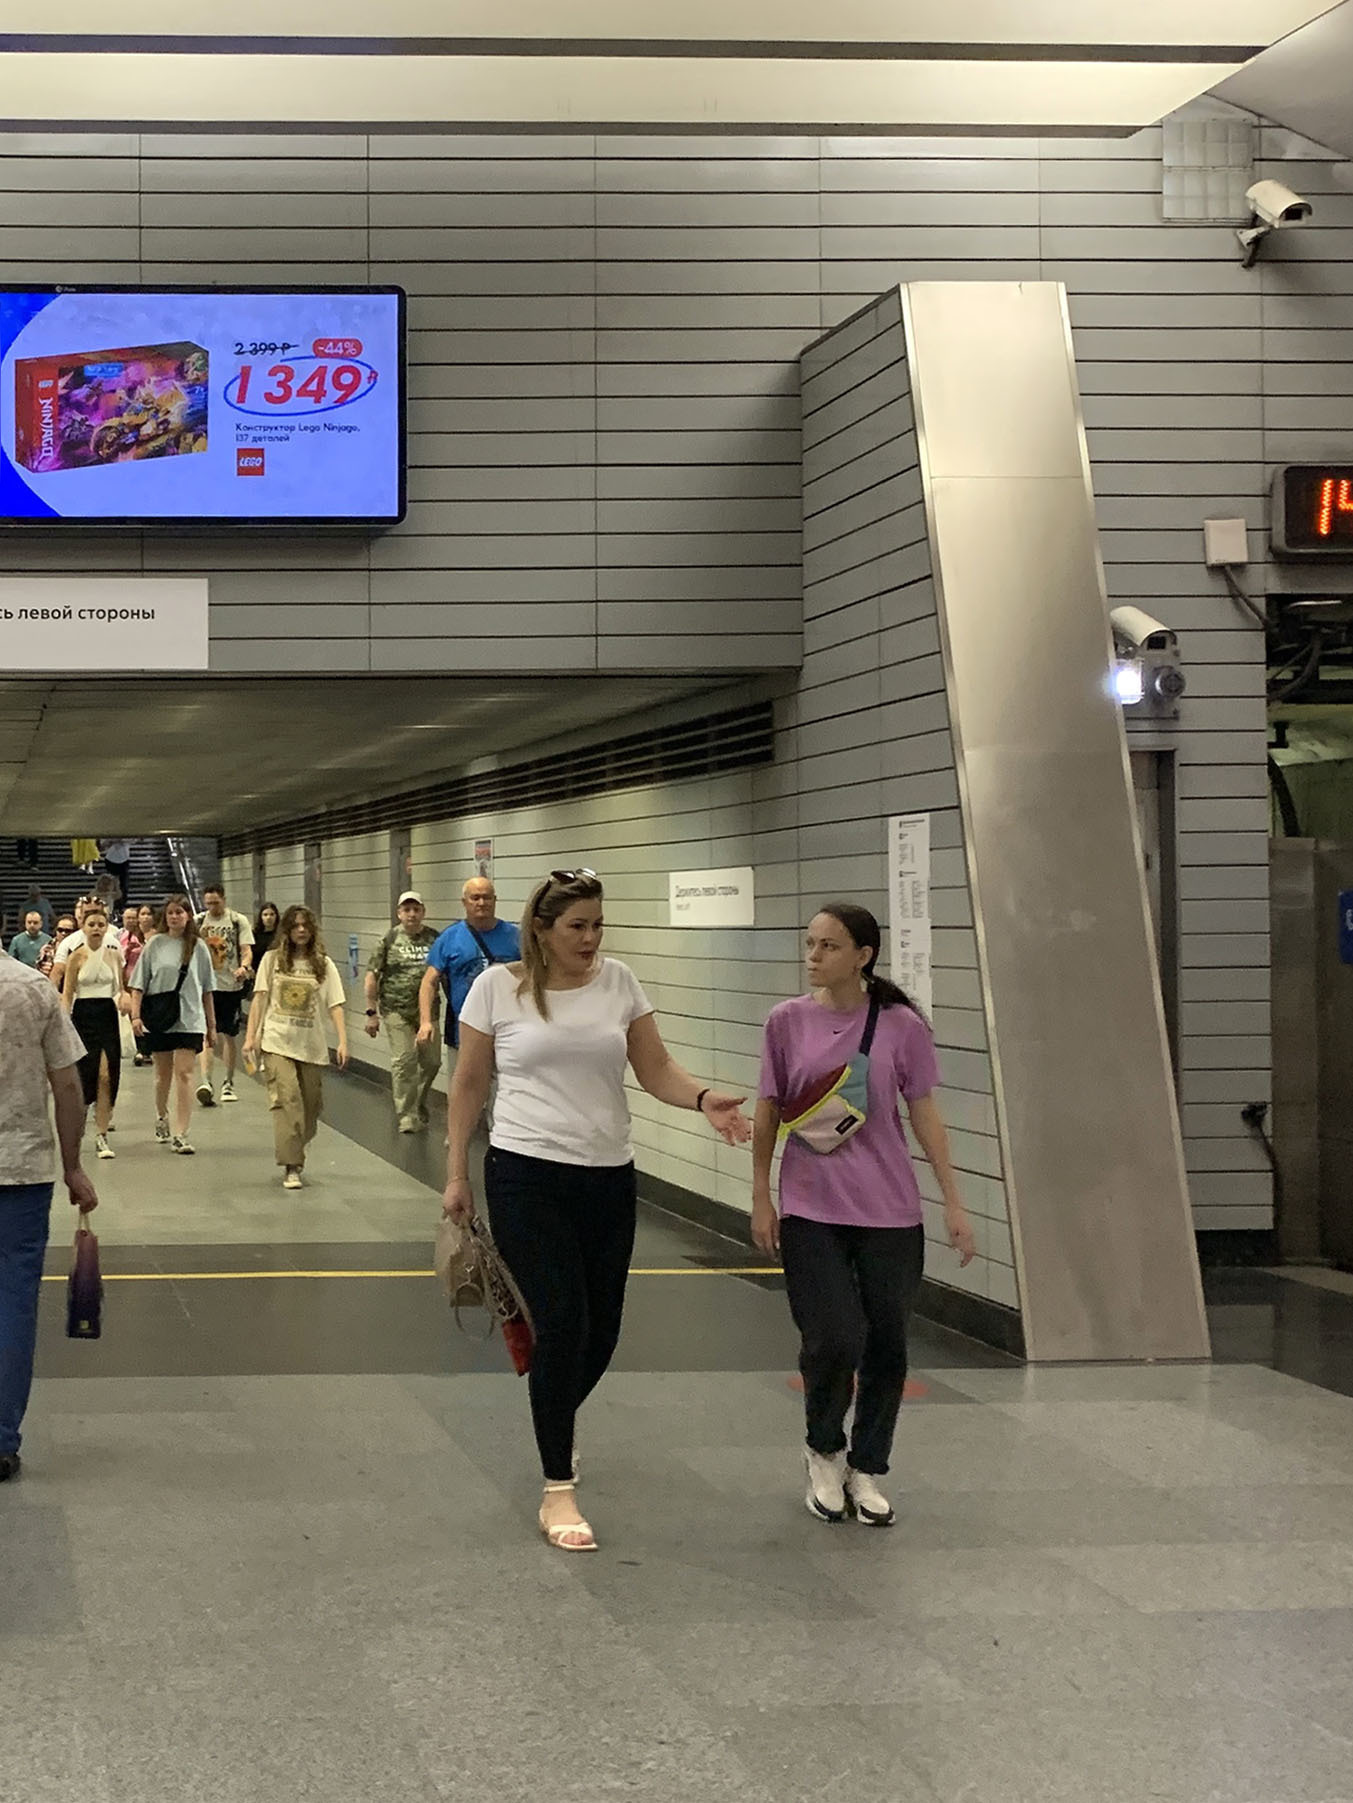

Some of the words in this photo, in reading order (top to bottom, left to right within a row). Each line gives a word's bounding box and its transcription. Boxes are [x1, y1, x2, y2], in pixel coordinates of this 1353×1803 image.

[317, 341, 357, 355] -44%
[264, 364, 362, 405] 349
[39, 397, 54, 460] NINJAGO
[235, 423, 296, 433] Конструктор
[299, 423, 321, 433] Lego
[236, 434, 248, 442] 137
[251, 433, 290, 443] деталей
[239, 457, 263, 467] LEGO
[18, 605, 73, 620] левой
[78, 606, 156, 623] стороны
